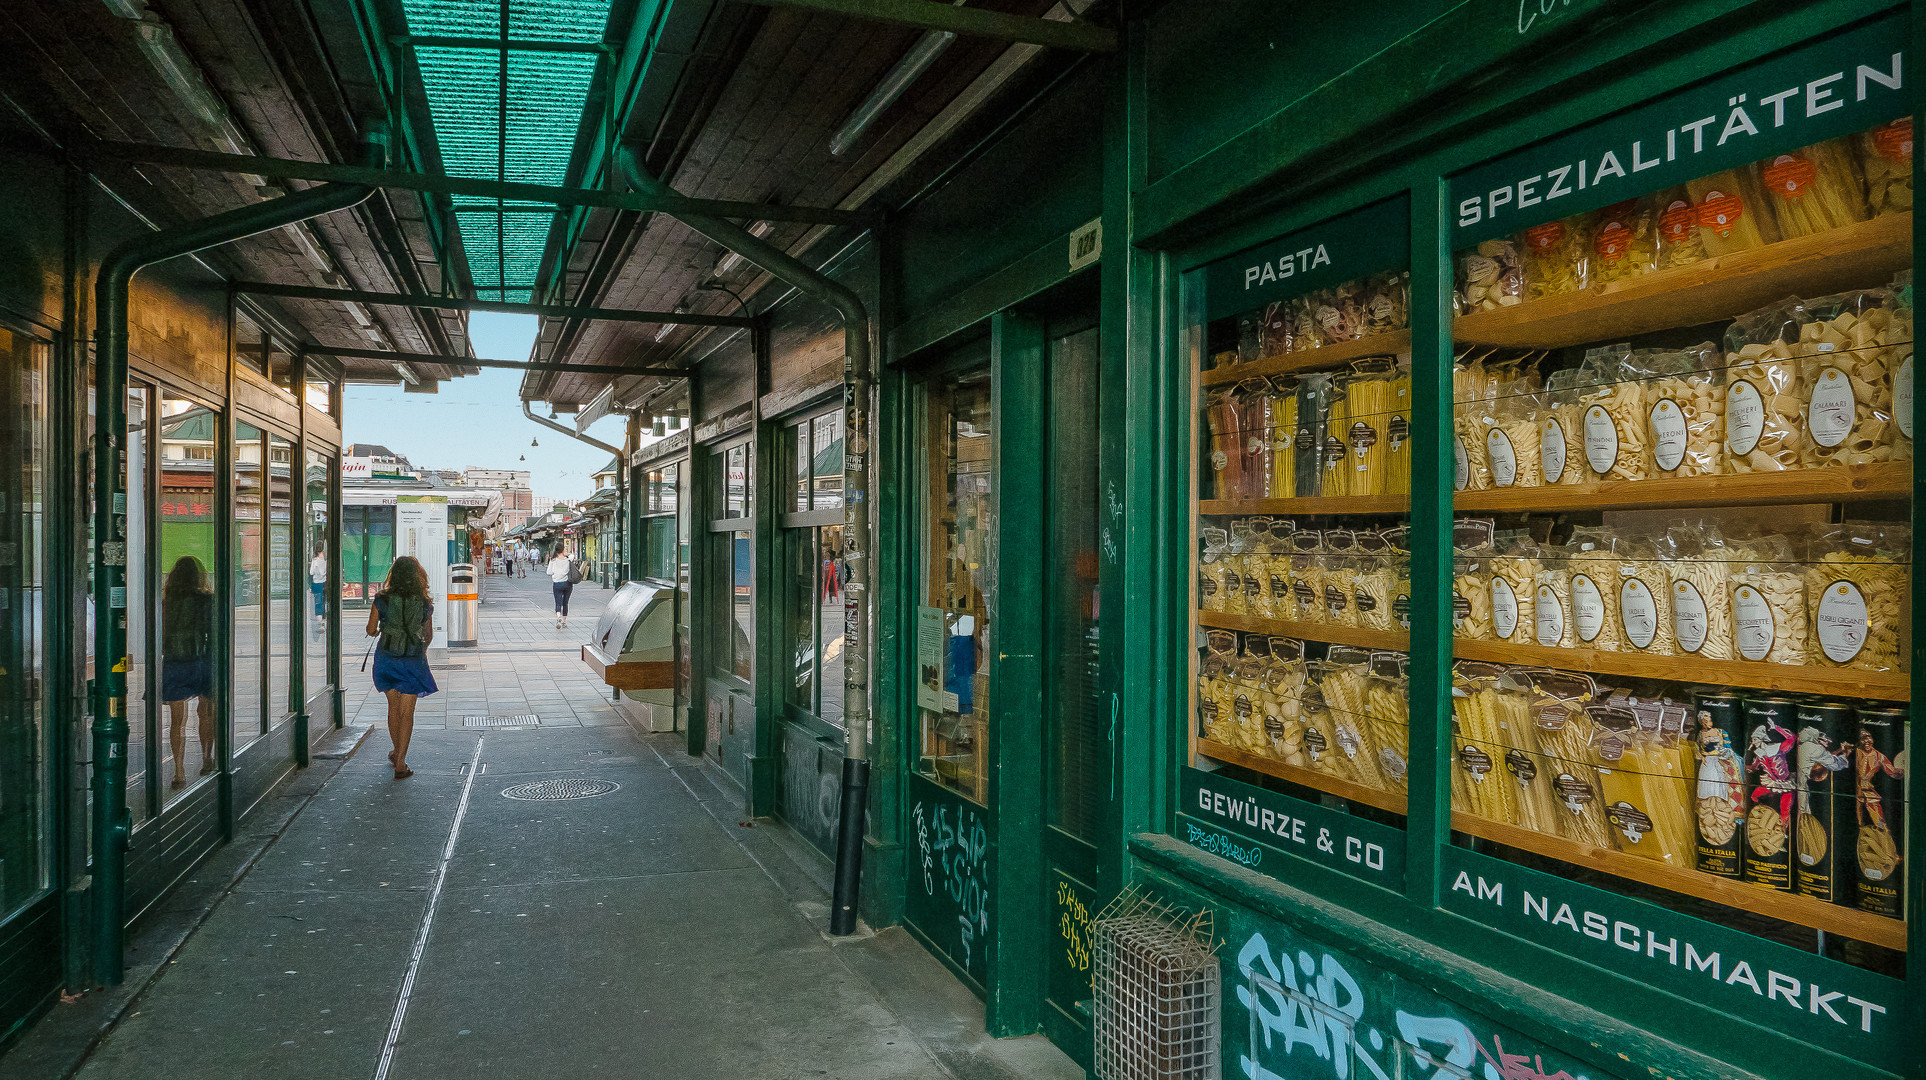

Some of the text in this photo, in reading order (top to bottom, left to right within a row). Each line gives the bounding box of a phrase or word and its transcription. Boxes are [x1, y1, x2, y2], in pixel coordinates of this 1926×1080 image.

[1458, 52, 1903, 228] SPEZIALITÄTEN
[1245, 243, 1331, 290] PASTA
[1814, 401, 1847, 409] CALAMARI
[447, 497, 480, 505] ALITÄTEN
[1199, 787, 1306, 843] GEWÜRZE
[1316, 827, 1334, 854] &
[1345, 836, 1384, 872] CO
[1451, 870, 1887, 1033] AM NASCHMARKT
